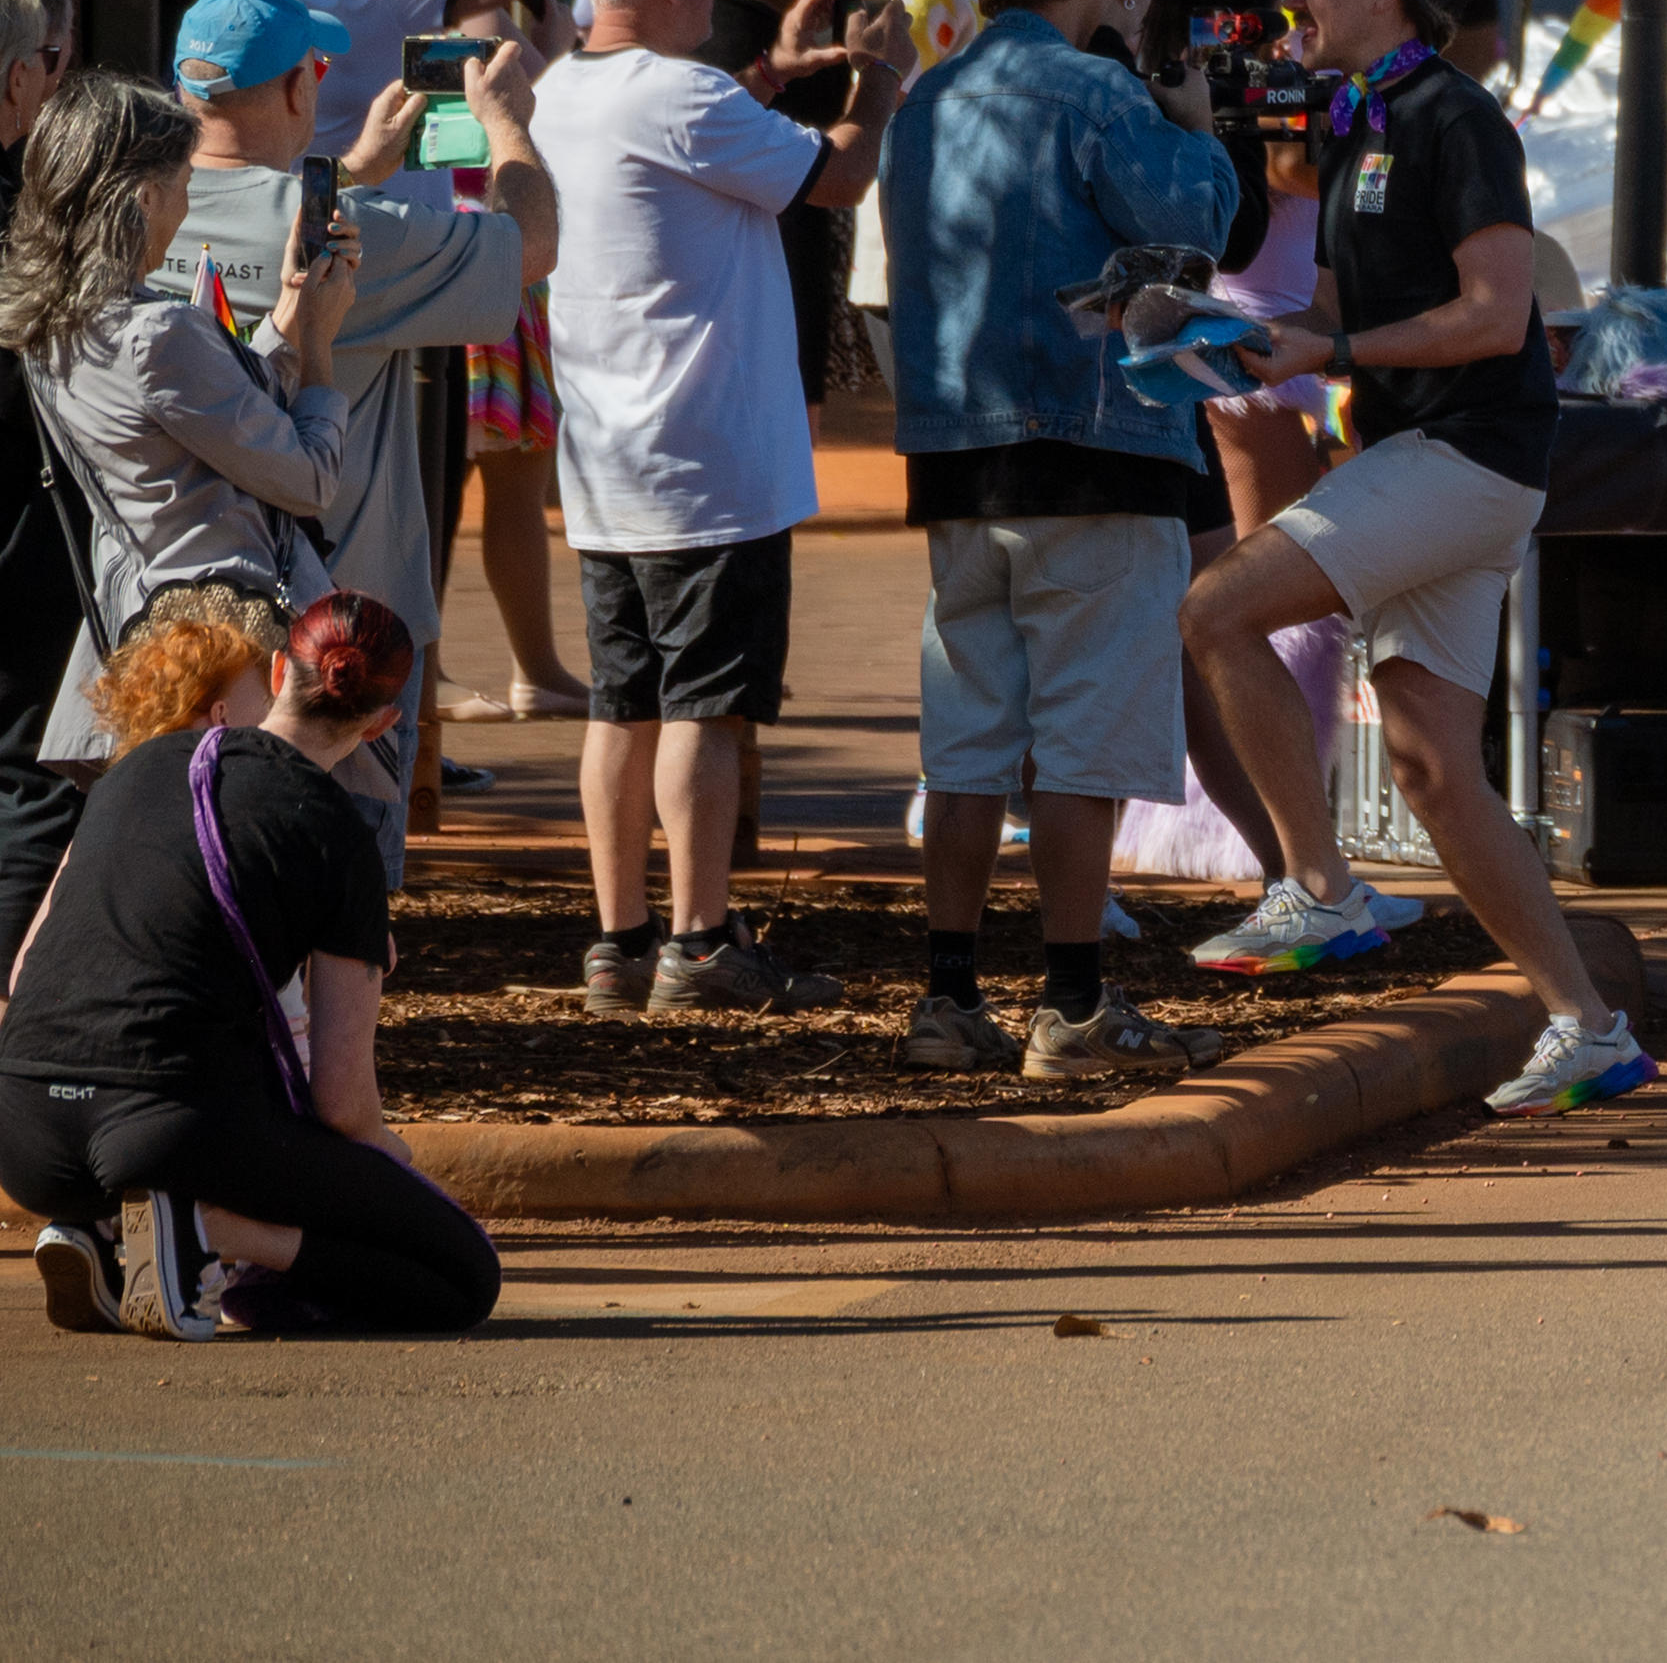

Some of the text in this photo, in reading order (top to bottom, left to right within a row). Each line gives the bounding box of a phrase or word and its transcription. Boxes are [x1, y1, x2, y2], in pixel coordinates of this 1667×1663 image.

[1266, 89, 1306, 104] RONIN
[1356, 190, 1384, 205] PRIDE
[49, 1084, 96, 1100] ECHT
